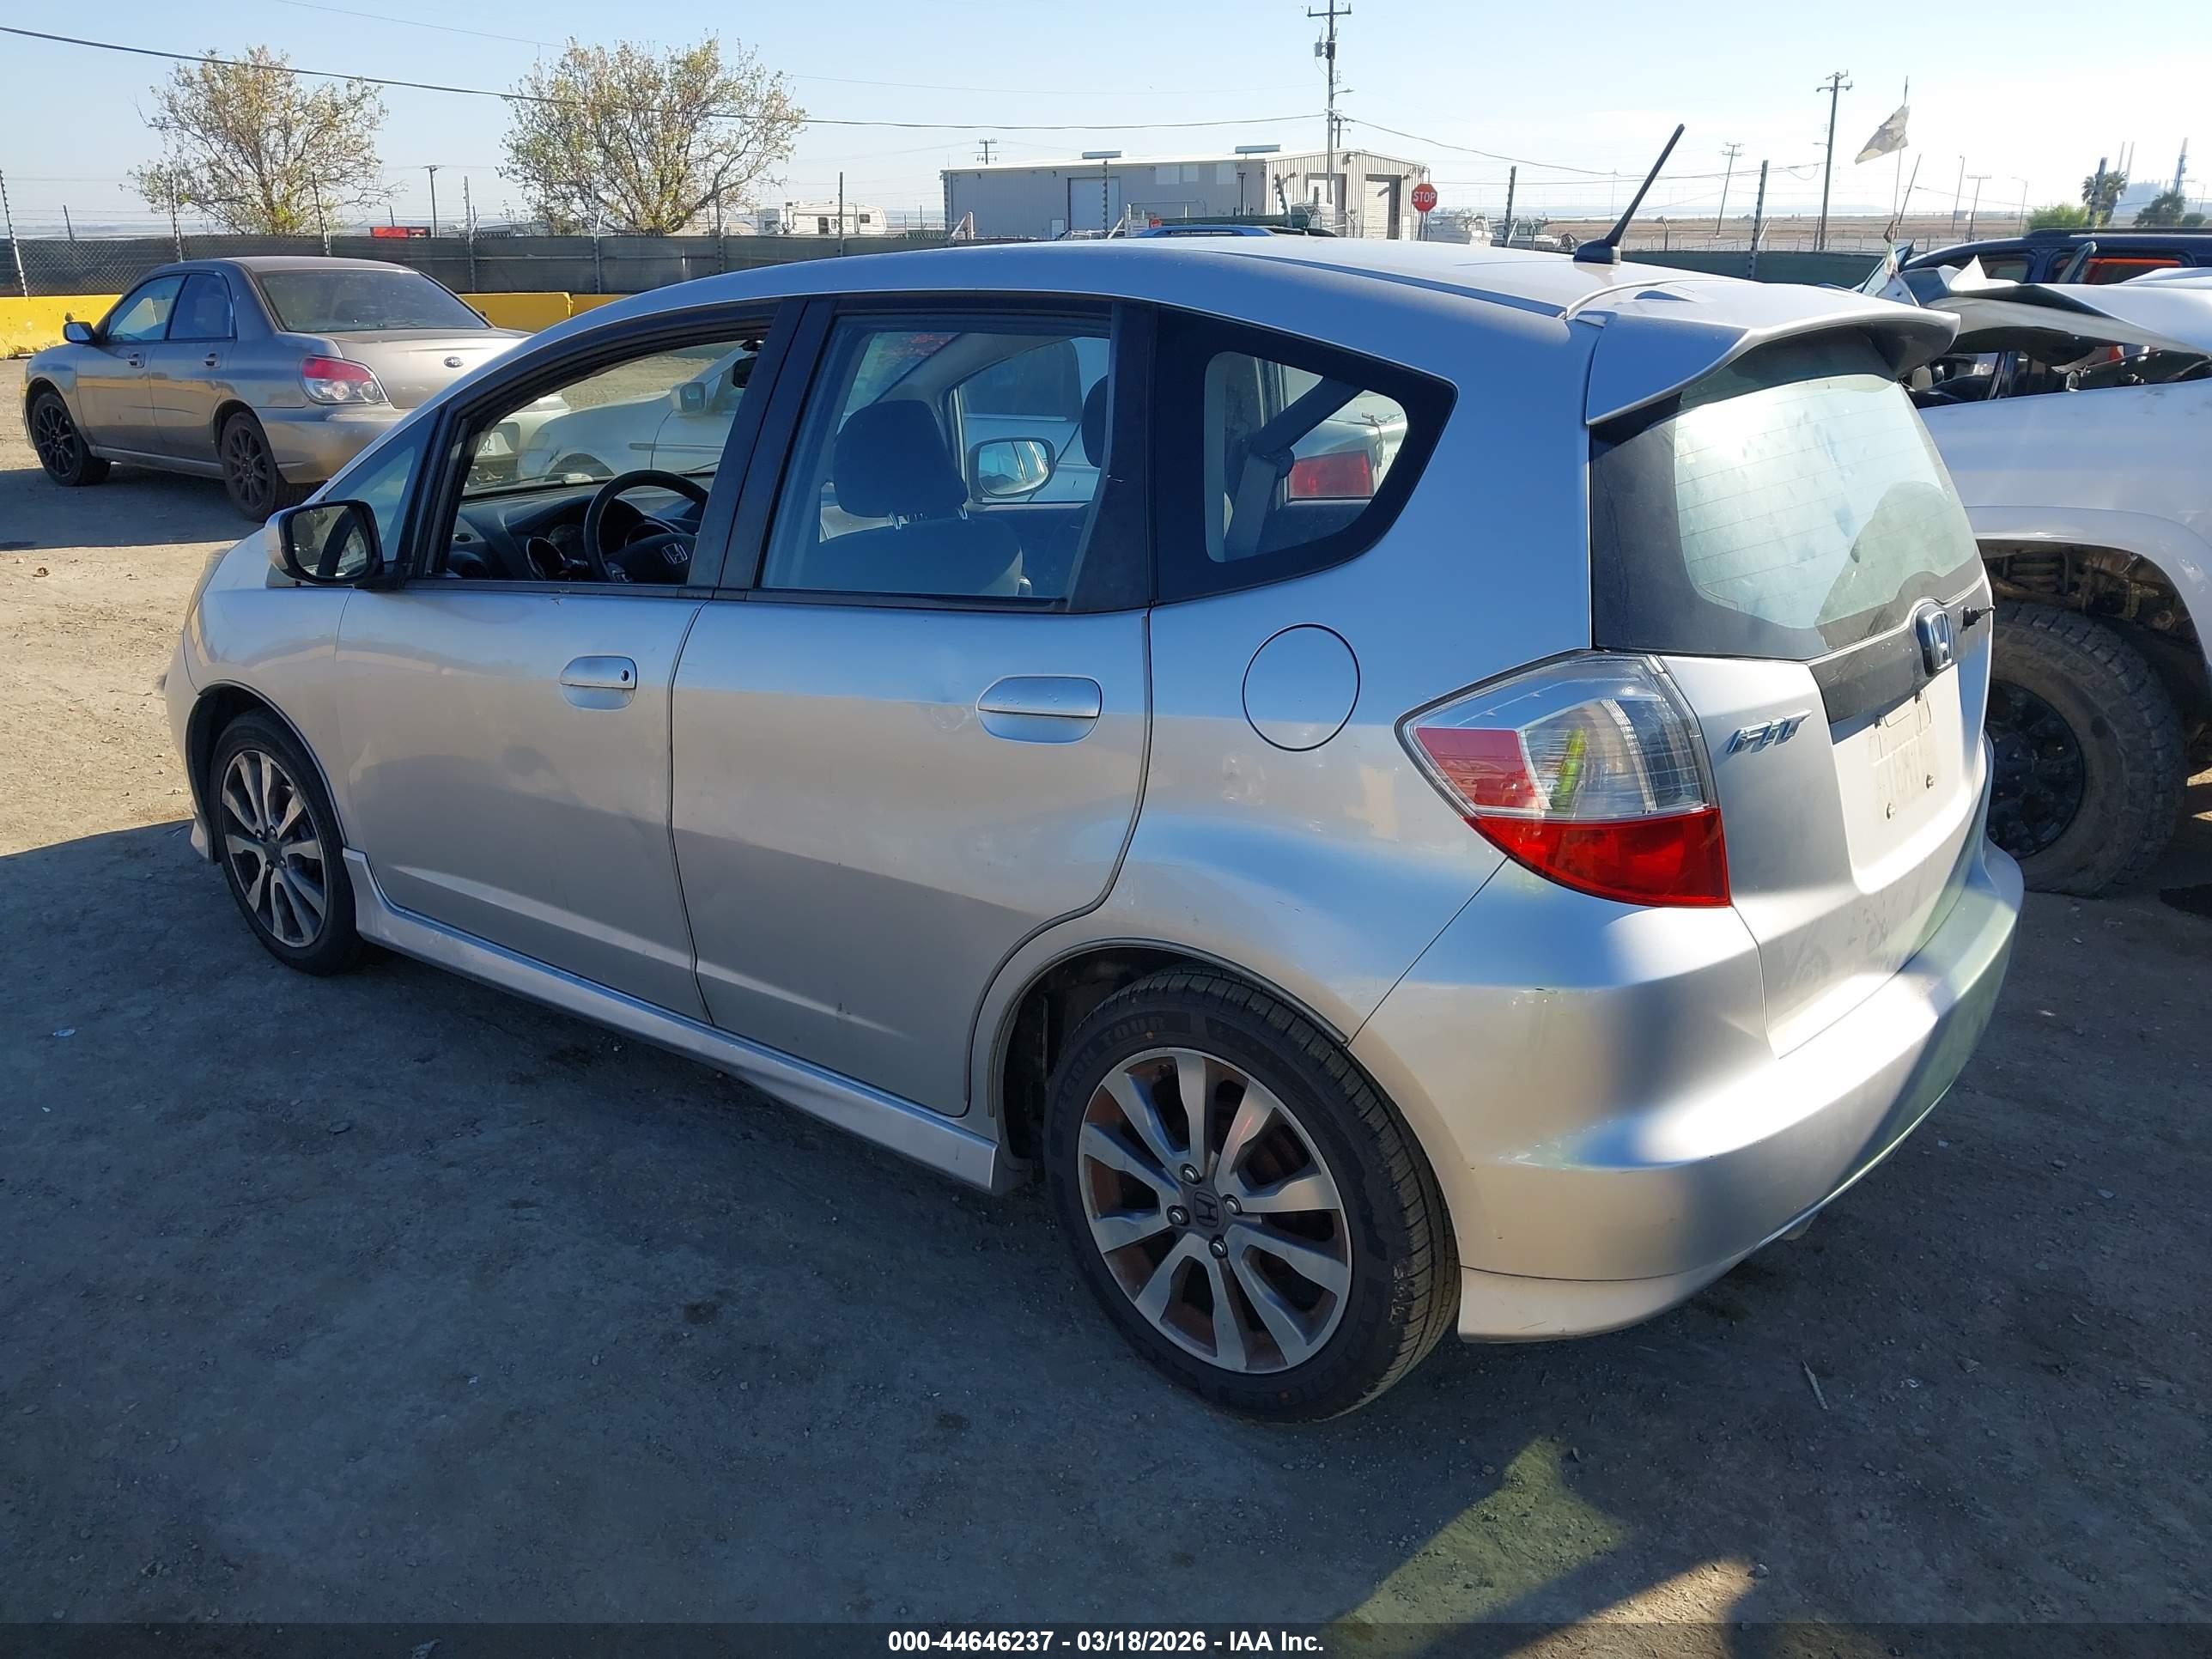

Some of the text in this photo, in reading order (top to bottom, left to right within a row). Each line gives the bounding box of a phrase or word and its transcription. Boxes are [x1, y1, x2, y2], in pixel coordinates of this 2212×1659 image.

[1413, 191, 1437, 204] STOP
[1725, 708, 1813, 755] FIT
[1099, 1016, 1166, 1045] TOUR
